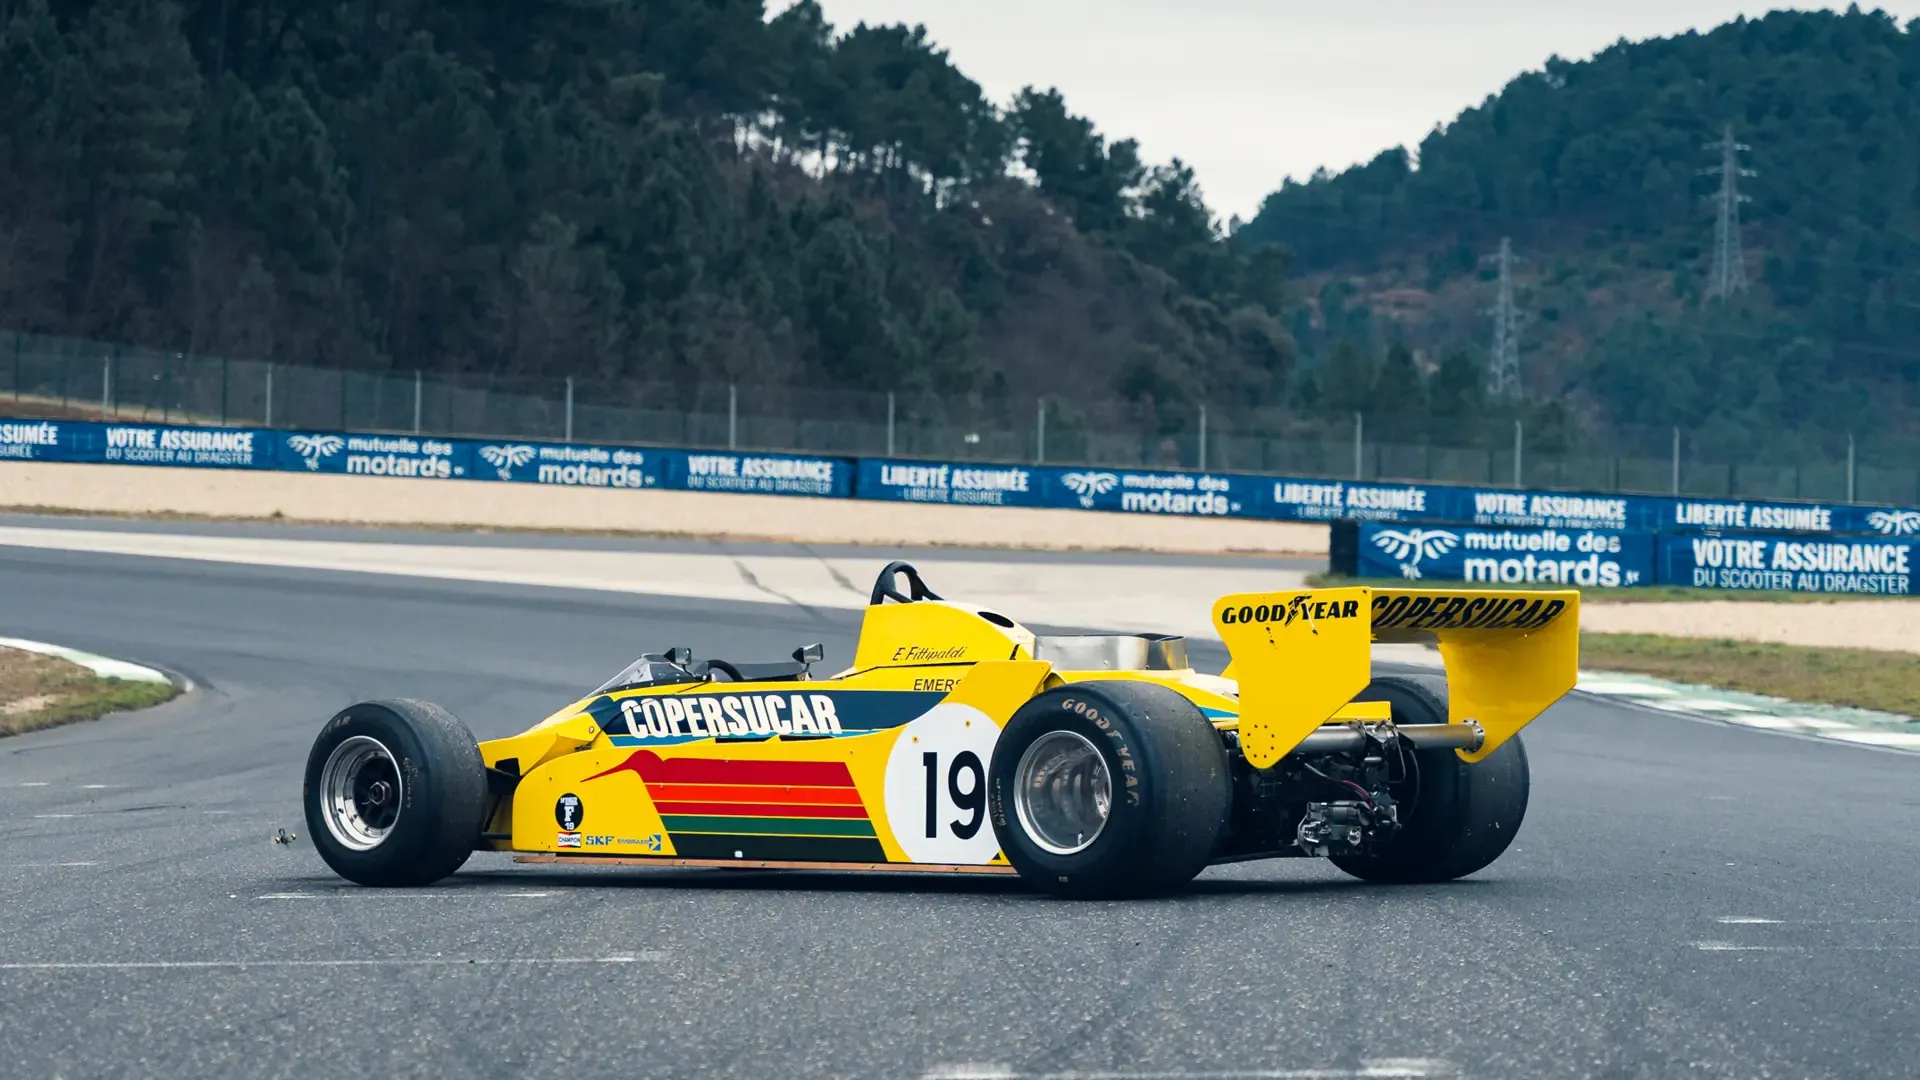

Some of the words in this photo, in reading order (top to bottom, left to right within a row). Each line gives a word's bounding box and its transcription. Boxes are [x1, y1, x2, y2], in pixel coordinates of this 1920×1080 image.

[0, 421, 58, 445] SUMÉE
[106, 428, 156, 448] VOTRE
[161, 430, 253, 452] ASSURANCE
[125, 448, 174, 462] SCOOTER
[348, 438, 419, 454] mutuelle
[422, 440, 453, 456] des
[540, 446, 610, 463] mutuelle
[612, 449, 644, 465] des
[346, 453, 451, 478] motards
[538, 463, 643, 487] motards
[688, 455, 738, 476] VOTRE
[742, 457, 833, 481] ASSURANCE
[881, 464, 949, 489] LIBERTÉ
[951, 467, 1030, 492] ASSUMÉE
[1122, 474, 1195, 490] mutuelle
[1198, 475, 1230, 491] des
[1121, 490, 1229, 515] motards
[1274, 482, 1343, 508] LIBERTÉ
[1346, 486, 1427, 511] ASSUMÉE
[1475, 493, 1527, 515] VOTRE
[1530, 496, 1627, 520] ASSURANCE
[1676, 498, 1747, 526] LIBERTÉ
[1751, 501, 1832, 530] ASSUMÉE
[1464, 530, 1571, 551] mutuelle
[1577, 531, 1621, 553] des
[1693, 539, 1767, 569] VOTRE
[1772, 542, 1911, 573] ASSURANCE
[1464, 554, 1621, 587] motards
[1694, 568, 1716, 587] DU
[1720, 569, 1793, 590] SCOOTER
[1798, 572, 1820, 591] AU
[1824, 573, 1910, 593] DRAGSTER
[905, 646, 968, 661] Fittipaldi
[620, 694, 842, 739] COPERSUCAR
[923, 751, 986, 840] 19
[585, 835, 614, 845] SKF
